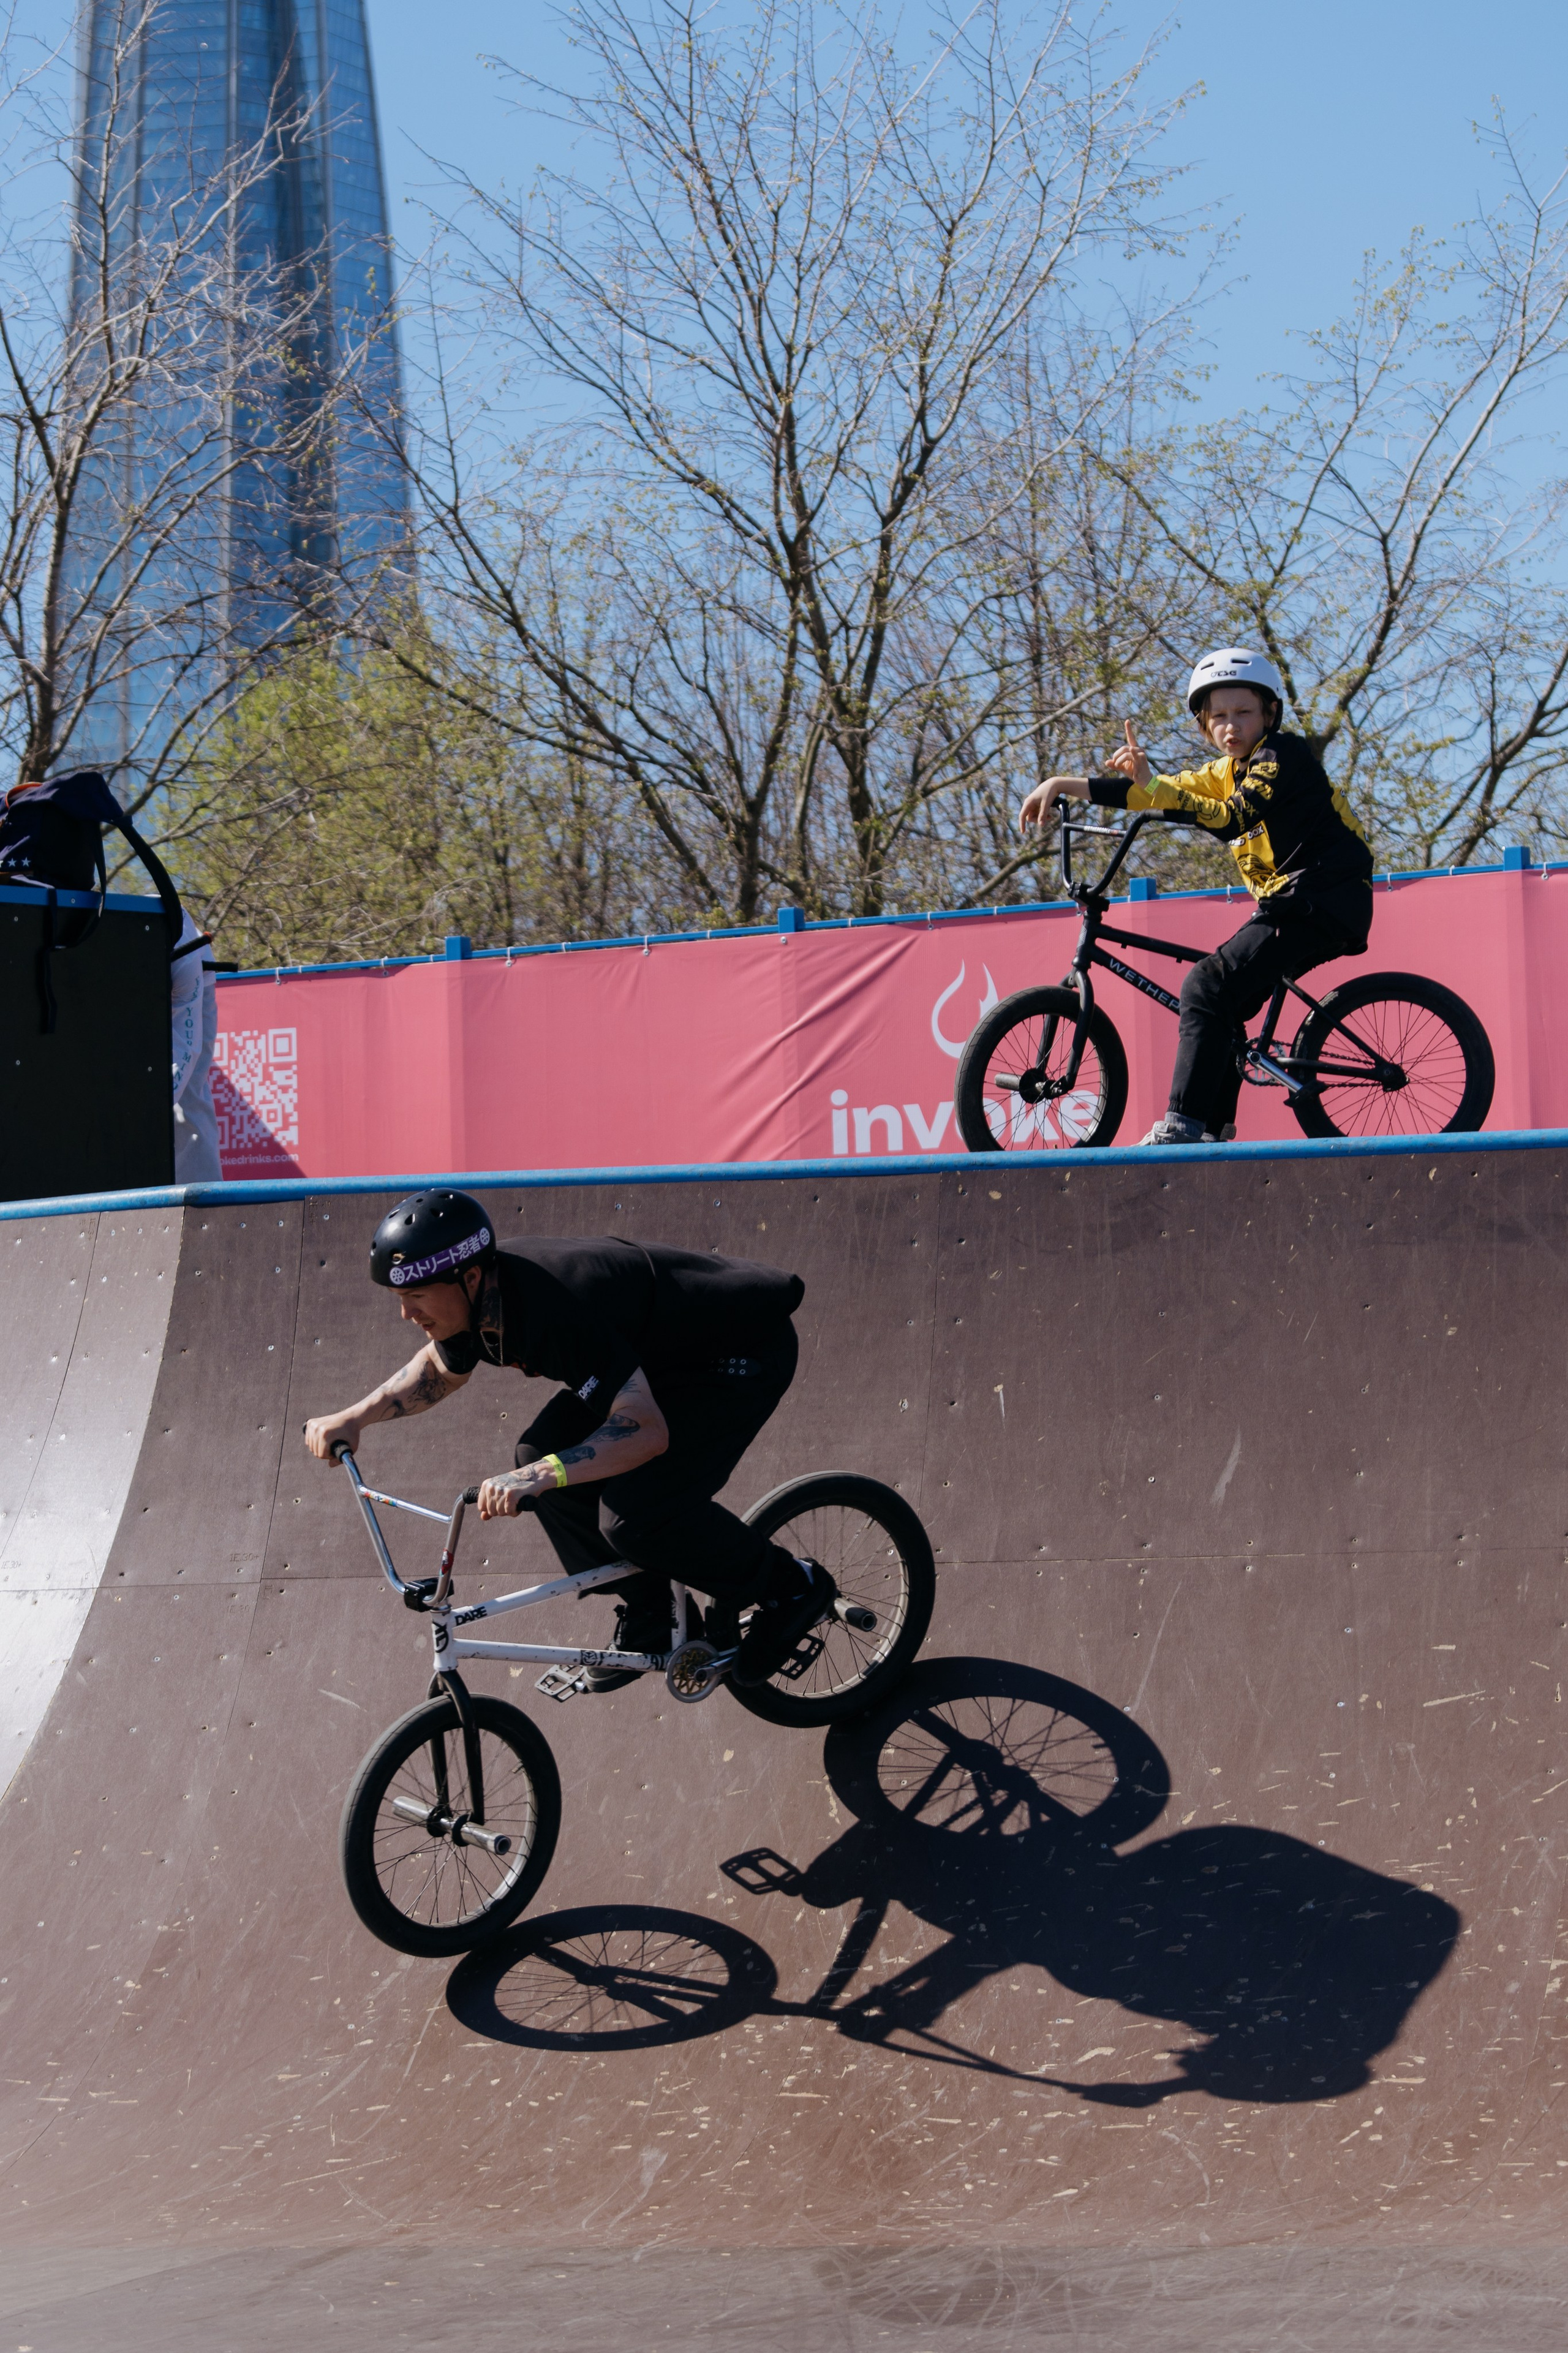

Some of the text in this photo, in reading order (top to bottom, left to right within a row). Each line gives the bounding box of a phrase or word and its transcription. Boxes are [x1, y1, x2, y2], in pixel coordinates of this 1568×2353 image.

[403, 1234, 481, 1281] ストリート忍者
[578, 1375, 599, 1399] DARE
[454, 1606, 488, 1626] DARE
